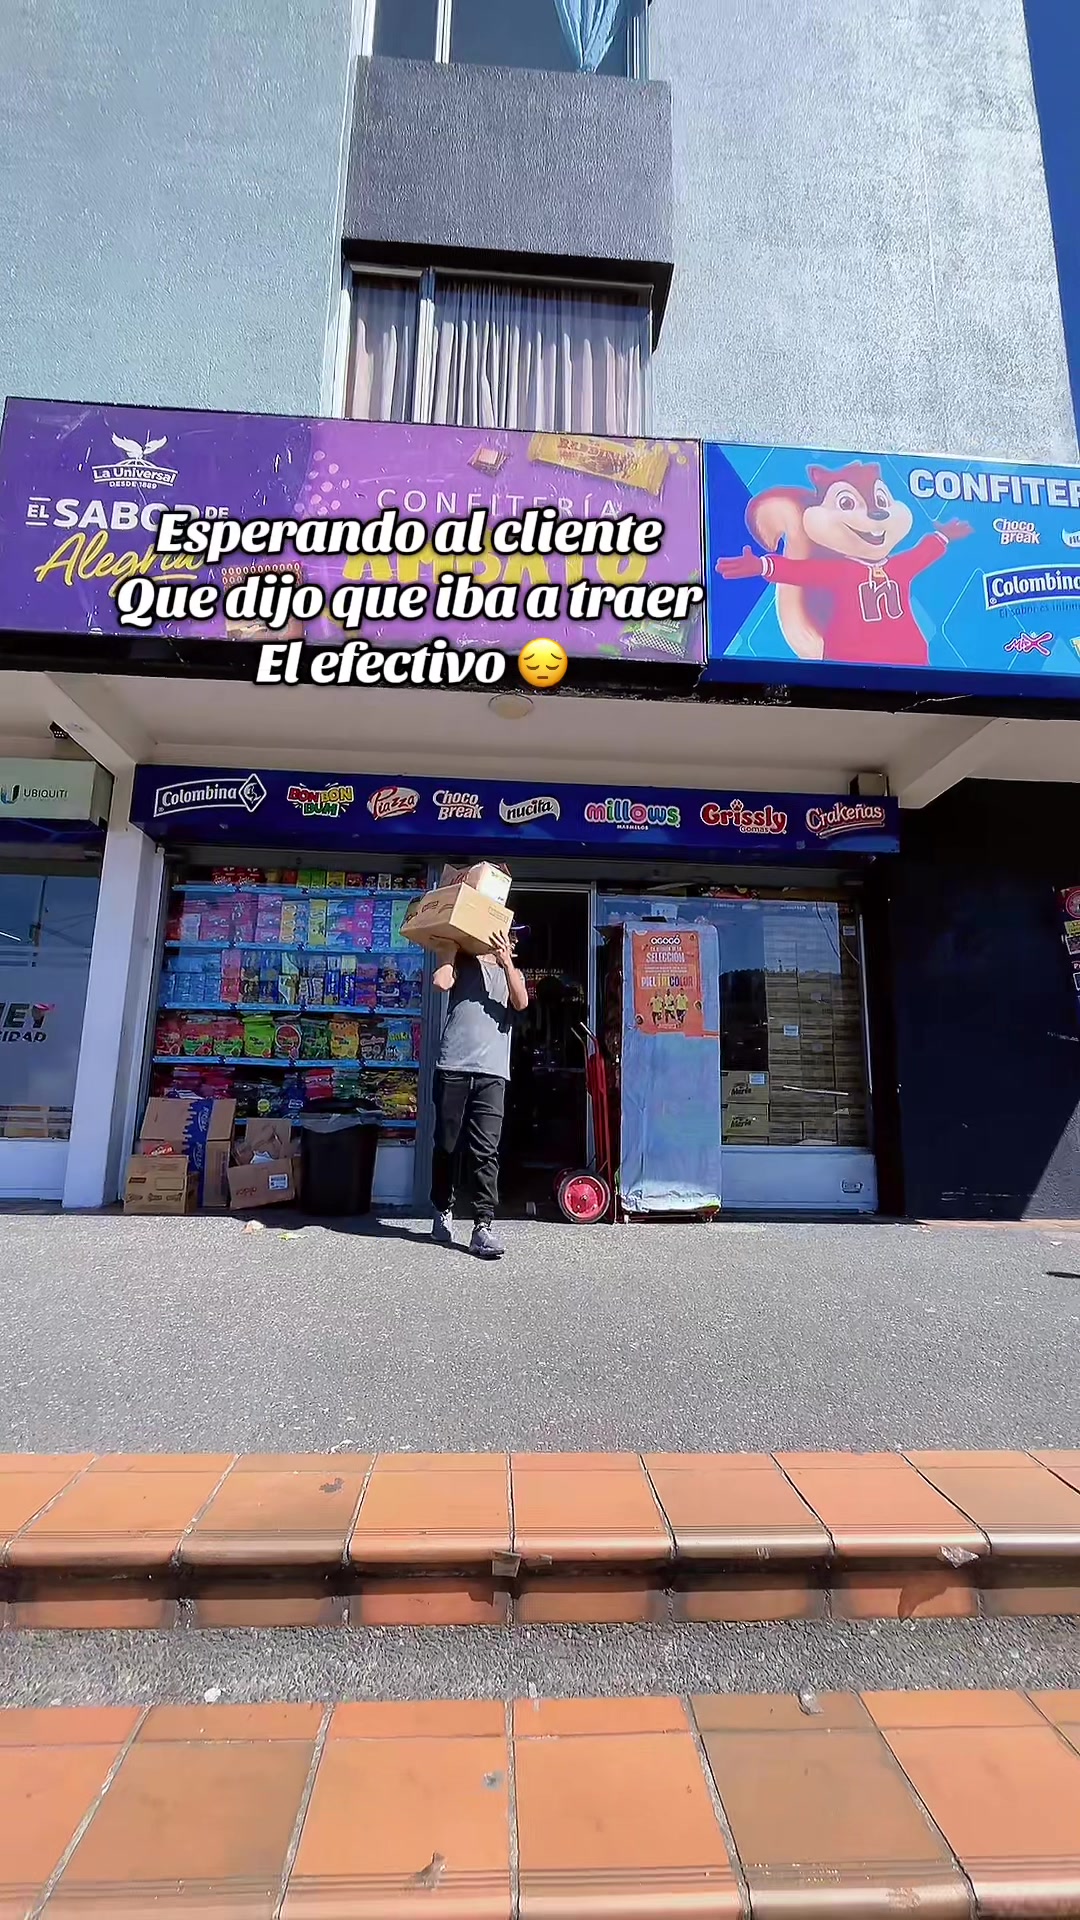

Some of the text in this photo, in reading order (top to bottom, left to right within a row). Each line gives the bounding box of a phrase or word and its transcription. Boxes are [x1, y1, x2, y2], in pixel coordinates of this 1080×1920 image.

[93, 467, 177, 483] La Universal
[109, 480, 157, 490] DESDE 1889
[27, 504, 50, 519] EL
[205, 506, 229, 519] DE
[992, 517, 1035, 532] Choco
[1000, 530, 1041, 545] Break
[23, 788, 68, 798] UBIQUITI
[162, 784, 237, 806] Colombina
[432, 790, 479, 806] Choco
[369, 786, 416, 819] Piazza
[506, 799, 554, 819] nucita
[437, 805, 484, 820] Break
[585, 798, 680, 826] millows
[700, 799, 787, 834] Grissly
[806, 802, 885, 833] Crakeñas
[740, 825, 770, 834] Gomas
[0, 1030, 48, 1043] IDAD
